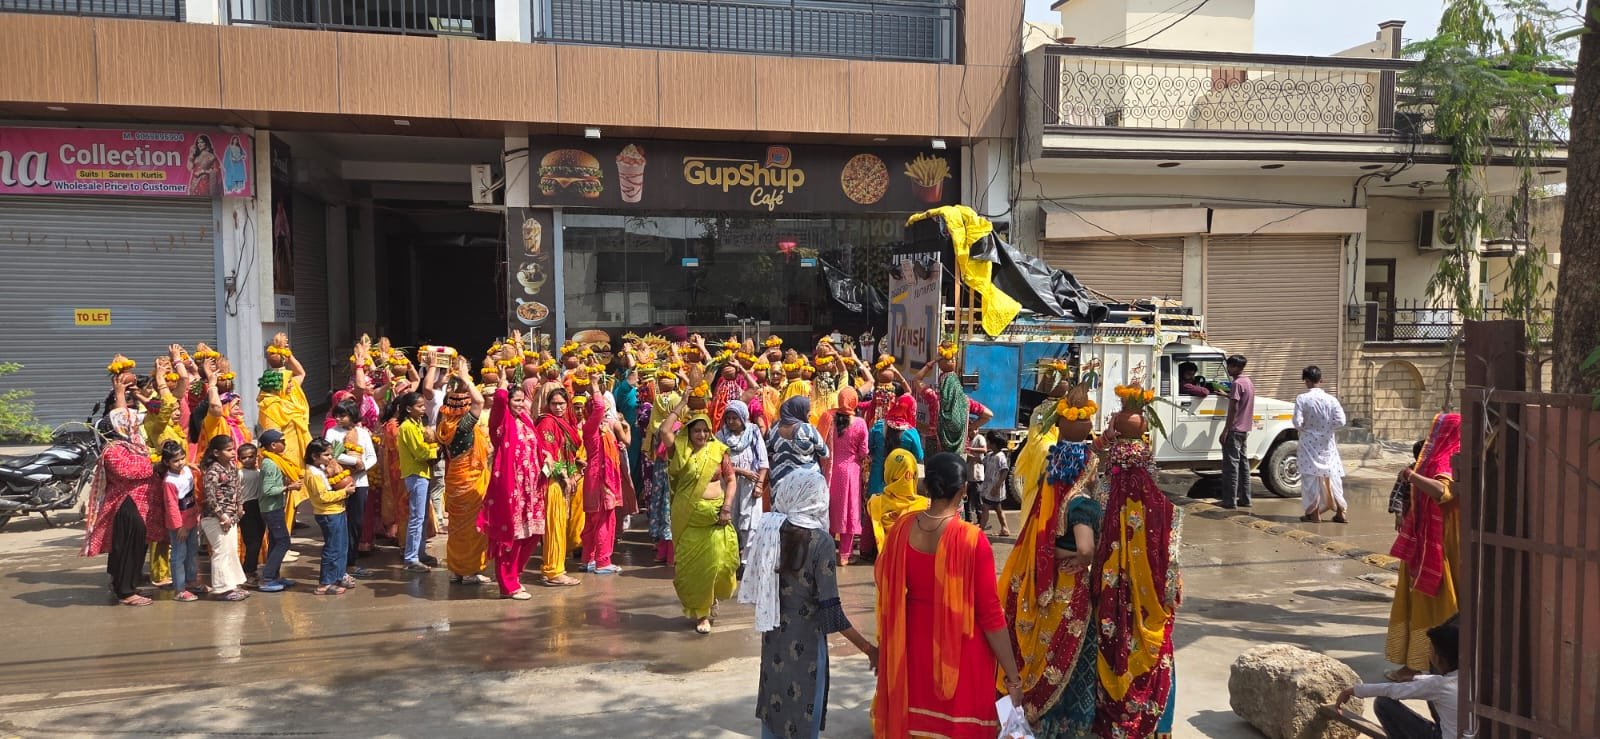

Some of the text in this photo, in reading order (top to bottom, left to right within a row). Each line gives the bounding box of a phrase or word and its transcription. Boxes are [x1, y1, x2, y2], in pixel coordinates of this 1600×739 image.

[59, 143, 181, 166] Collection
[80, 170, 164, 179] Suits Sarees Kurtis
[683, 160, 805, 193] GupShup
[54, 181, 187, 192] Wholesale Price to Customer
[750, 187, 784, 212] Café
[77, 312, 109, 322] TO LET
[895, 326, 926, 355] VANSH
